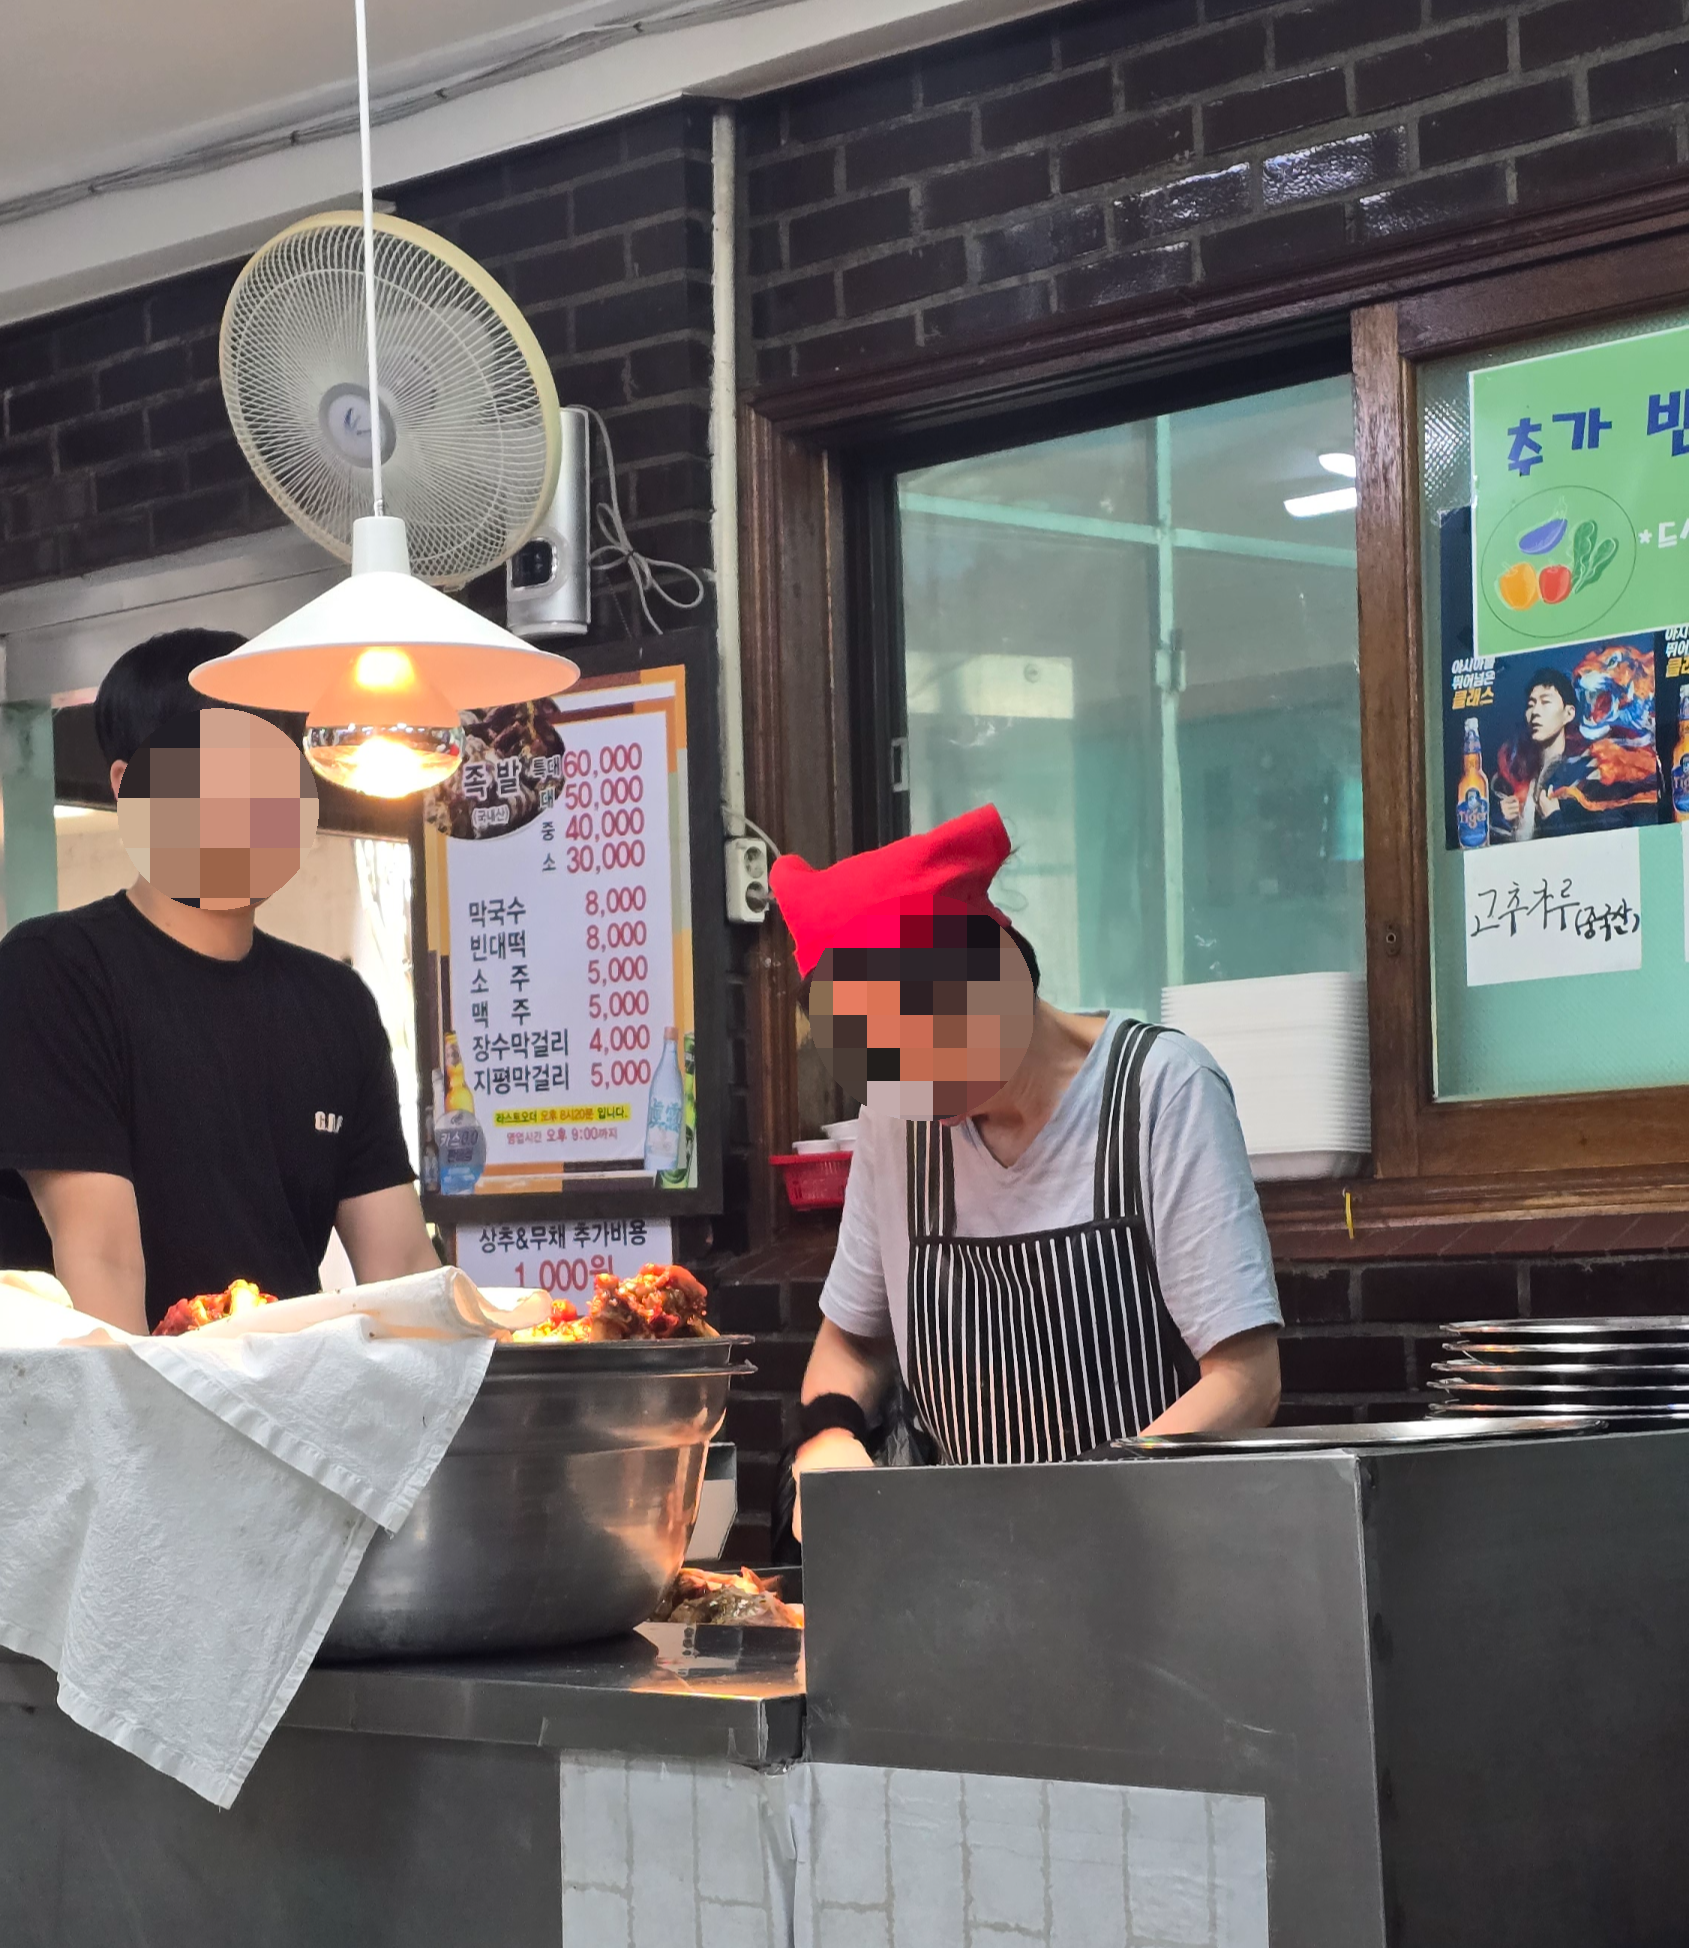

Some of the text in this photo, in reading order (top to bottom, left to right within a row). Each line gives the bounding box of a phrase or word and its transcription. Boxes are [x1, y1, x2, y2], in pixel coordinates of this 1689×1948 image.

[1507, 407, 1612, 476] 추가
[1452, 686, 1494, 710] 클래스
[563, 743, 642, 777] 60,000
[540, 775, 643, 811] 대 50,000
[472, 806, 509, 825] (국내산)
[541, 808, 644, 842] 중 40,000
[1459, 809, 1487, 829] Tiger
[542, 840, 645, 874] 소 30,000
[469, 886, 646, 927] 막국수 8,000
[470, 921, 647, 962] 빈대떡 8,000
[588, 956, 648, 987] 5,000
[589, 990, 649, 1021] 5,000
[473, 1024, 650, 1062] 장수막걸리 4,000
[473, 1060, 651, 1095] 지평막걸리 5,000
[496, 1106, 628, 1123] 라스트오더 오후 8시20분 입니다.
[507, 1127, 618, 1145] 영업시간 오후 9:00까지
[479, 1218, 647, 1253] 상추&무채 추가비용
